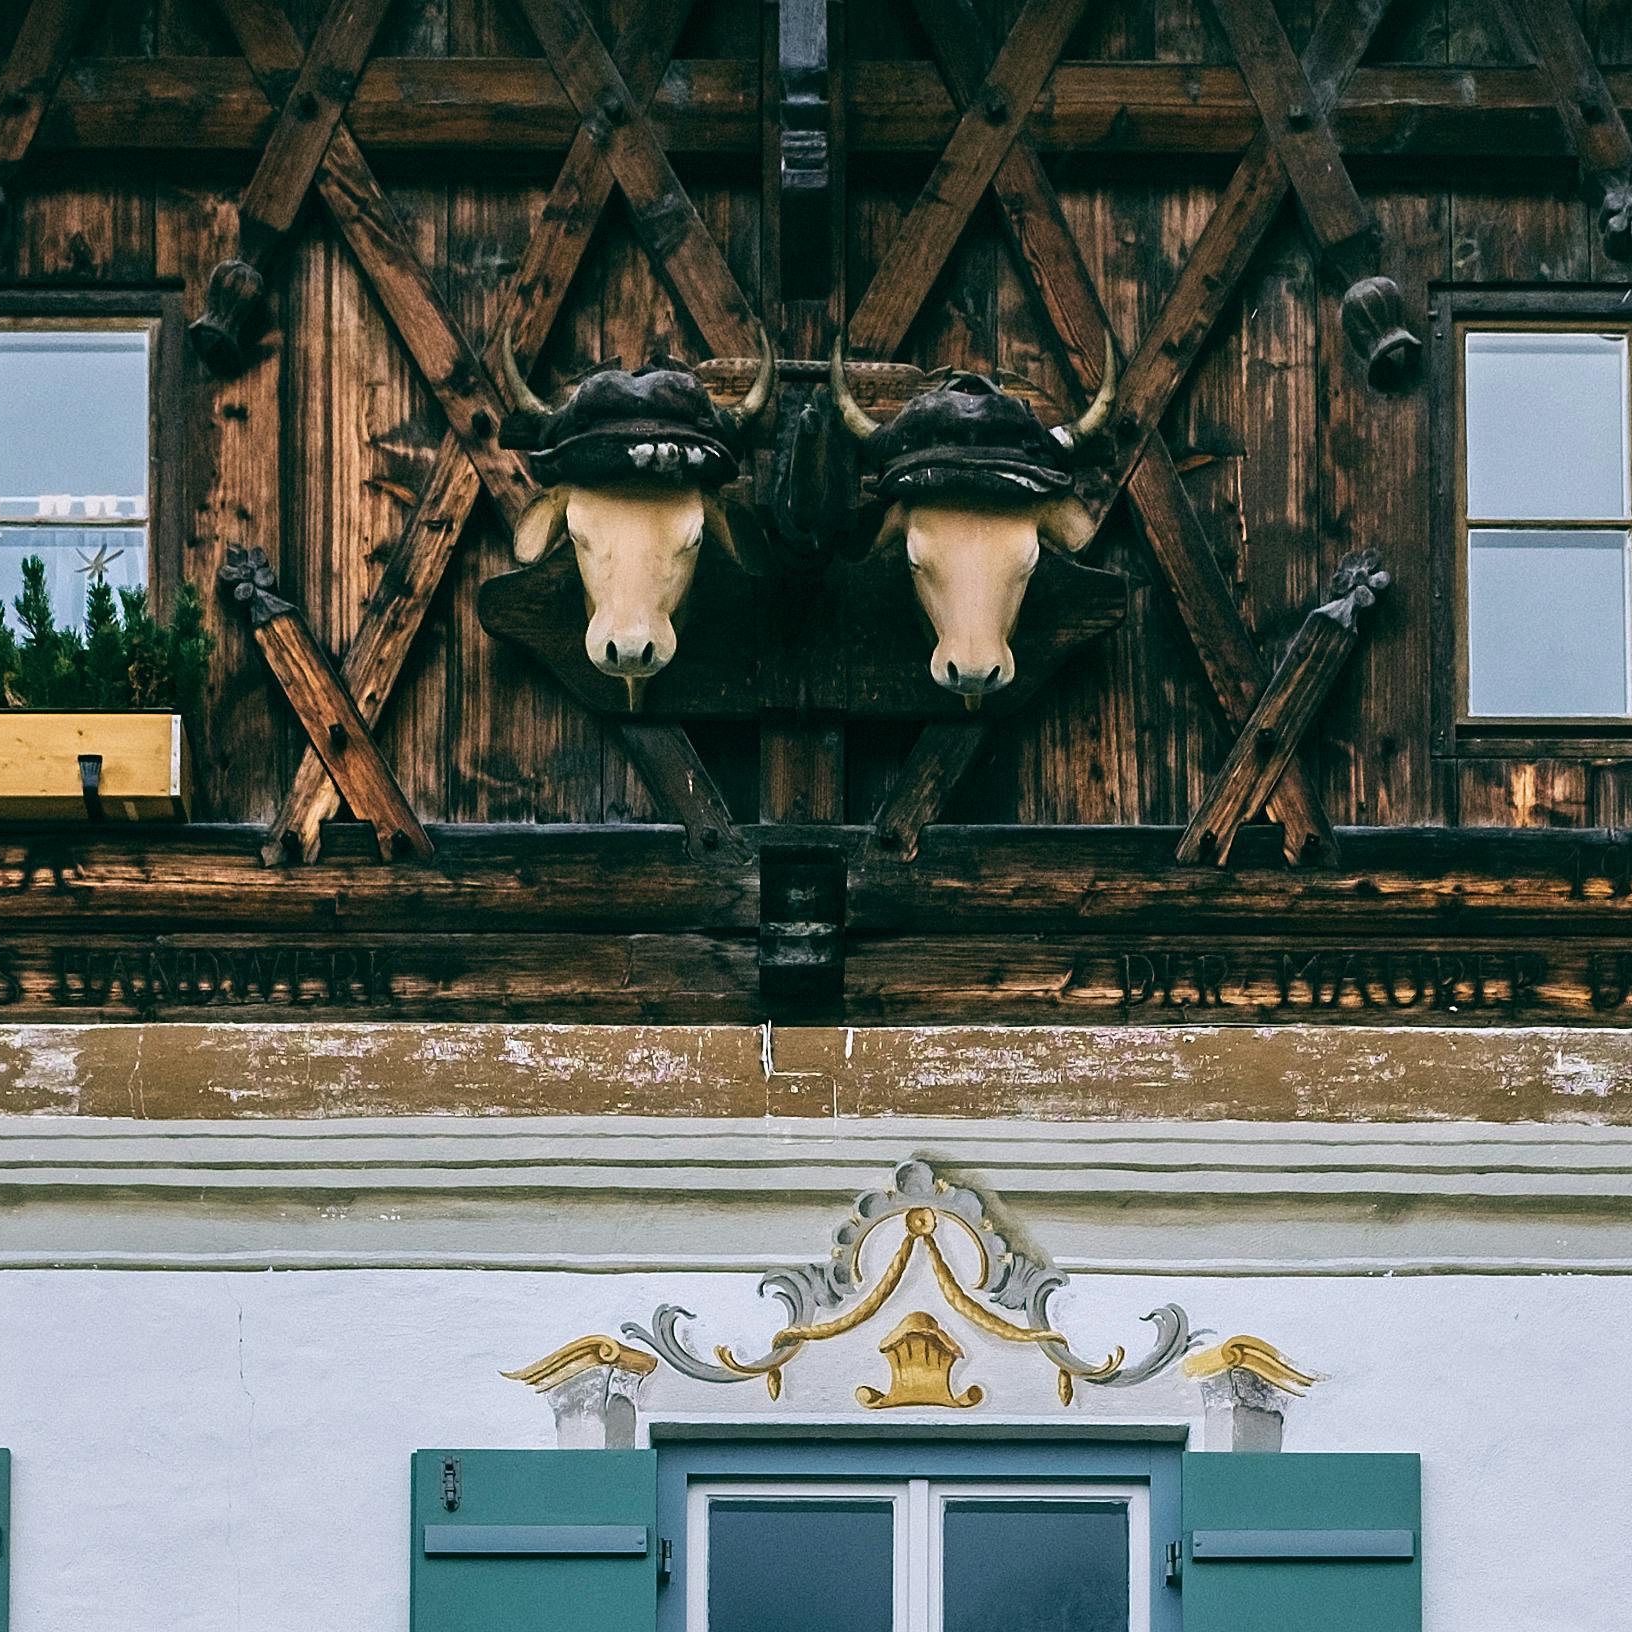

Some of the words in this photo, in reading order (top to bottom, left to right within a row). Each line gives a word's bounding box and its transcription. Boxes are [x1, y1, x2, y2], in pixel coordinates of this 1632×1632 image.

[53, 948, 398, 1009] HANDWERK
[1118, 952, 1230, 1010] DER
[1277, 952, 1546, 1011] MAURER
